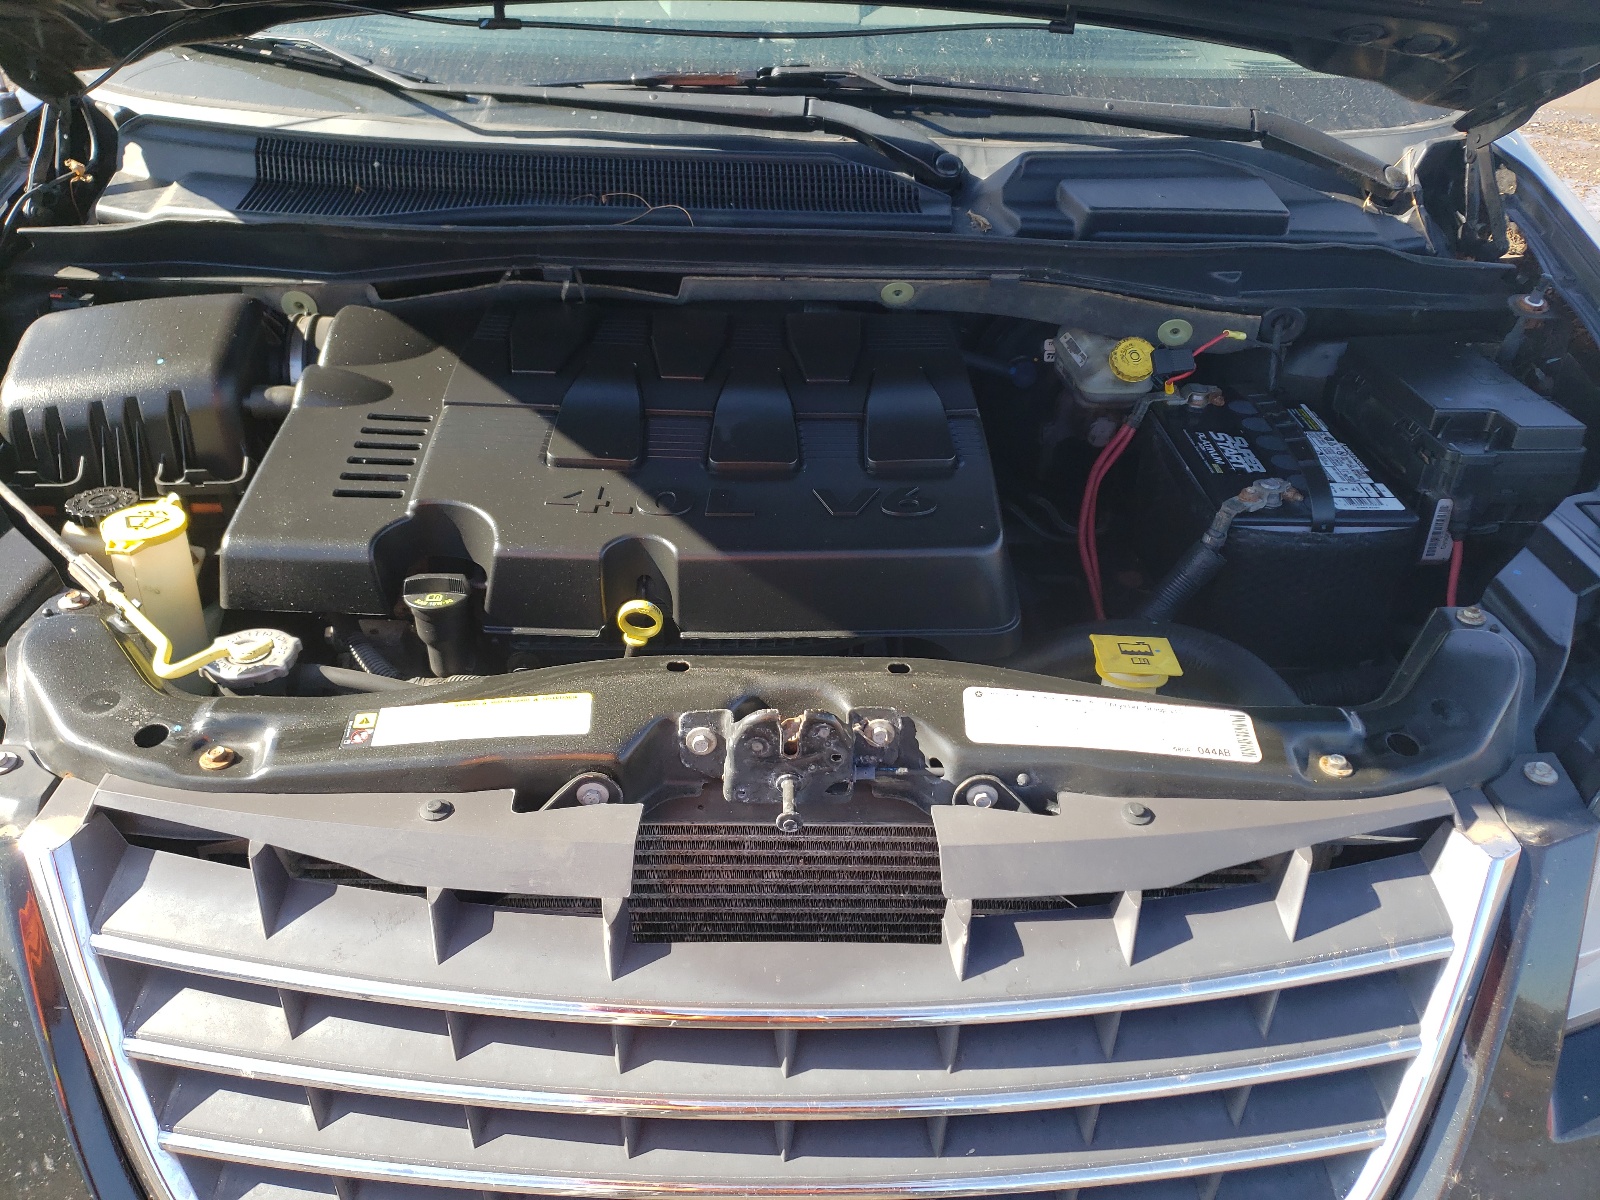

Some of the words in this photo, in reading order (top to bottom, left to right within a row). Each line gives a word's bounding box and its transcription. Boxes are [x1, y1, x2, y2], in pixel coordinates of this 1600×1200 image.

[1195, 431, 1225, 464] PLATINUM
[1208, 430, 1253, 472] START
[1232, 436, 1267, 472] SUPER
[811, 486, 939, 517] V6
[1197, 746, 1231, 757] 044AB
